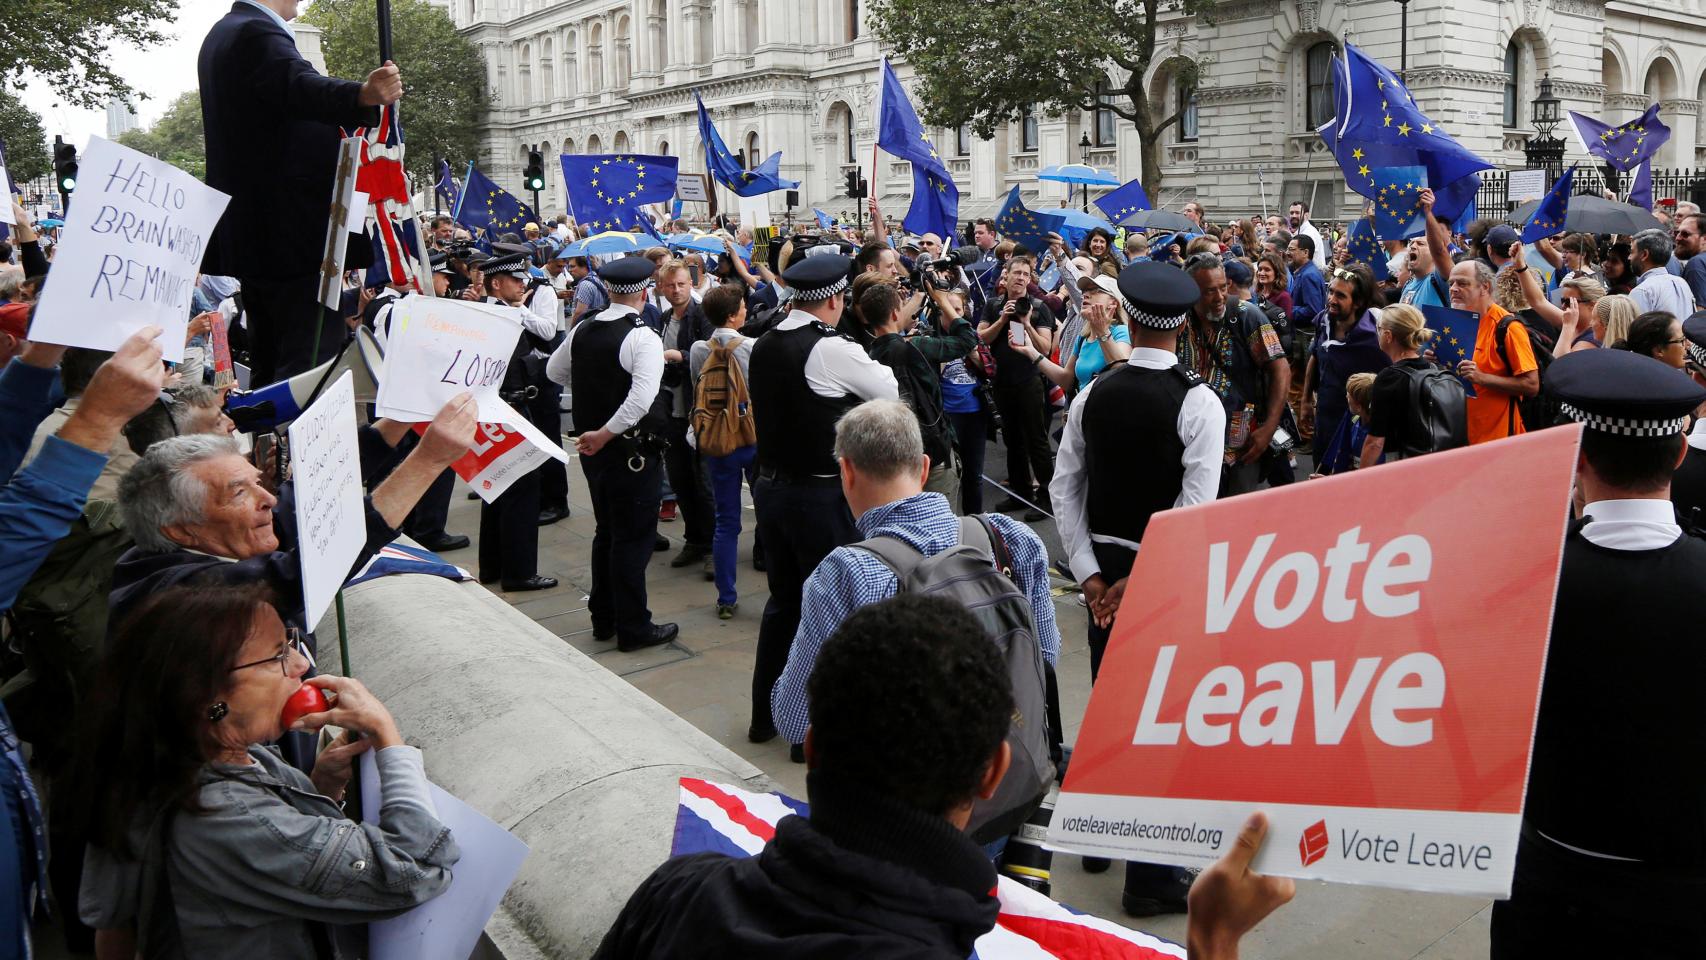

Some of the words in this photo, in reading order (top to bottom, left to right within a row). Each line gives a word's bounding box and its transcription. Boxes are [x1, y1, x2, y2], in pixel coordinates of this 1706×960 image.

[104, 158, 185, 213] HELLO
[1205, 525, 1433, 634] Vote
[1132, 645, 1446, 747] Leave
[1062, 815, 1223, 850] voteleavetakecontrol.org
[1341, 828, 1399, 864] Vote
[1407, 832, 1492, 871] Leave
